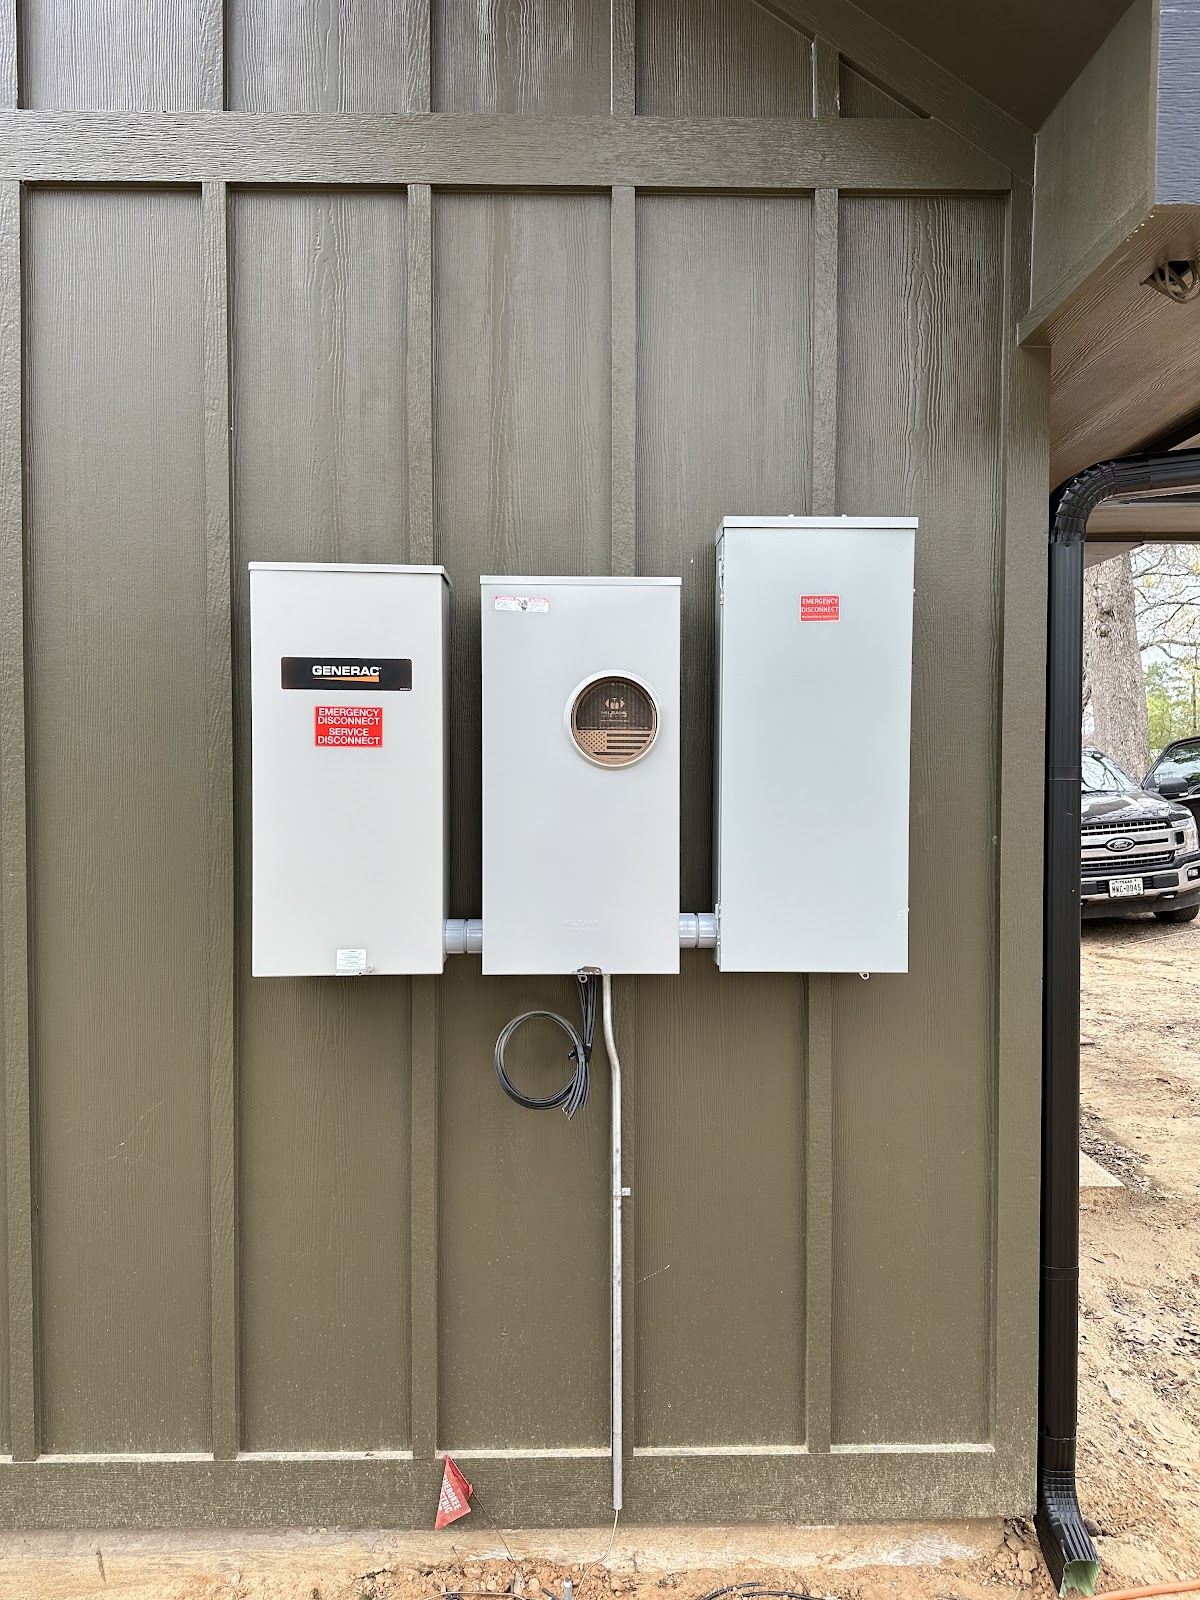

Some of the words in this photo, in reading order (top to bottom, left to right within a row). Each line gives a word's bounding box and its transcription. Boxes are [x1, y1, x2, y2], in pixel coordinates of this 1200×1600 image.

[312, 665, 380, 676] GENERAC
[318, 708, 380, 717] EMERGENCY
[317, 716, 381, 726] DISCONNECT
[328, 727, 370, 737] SERVICE
[317, 736, 381, 745] DISCONNECT
